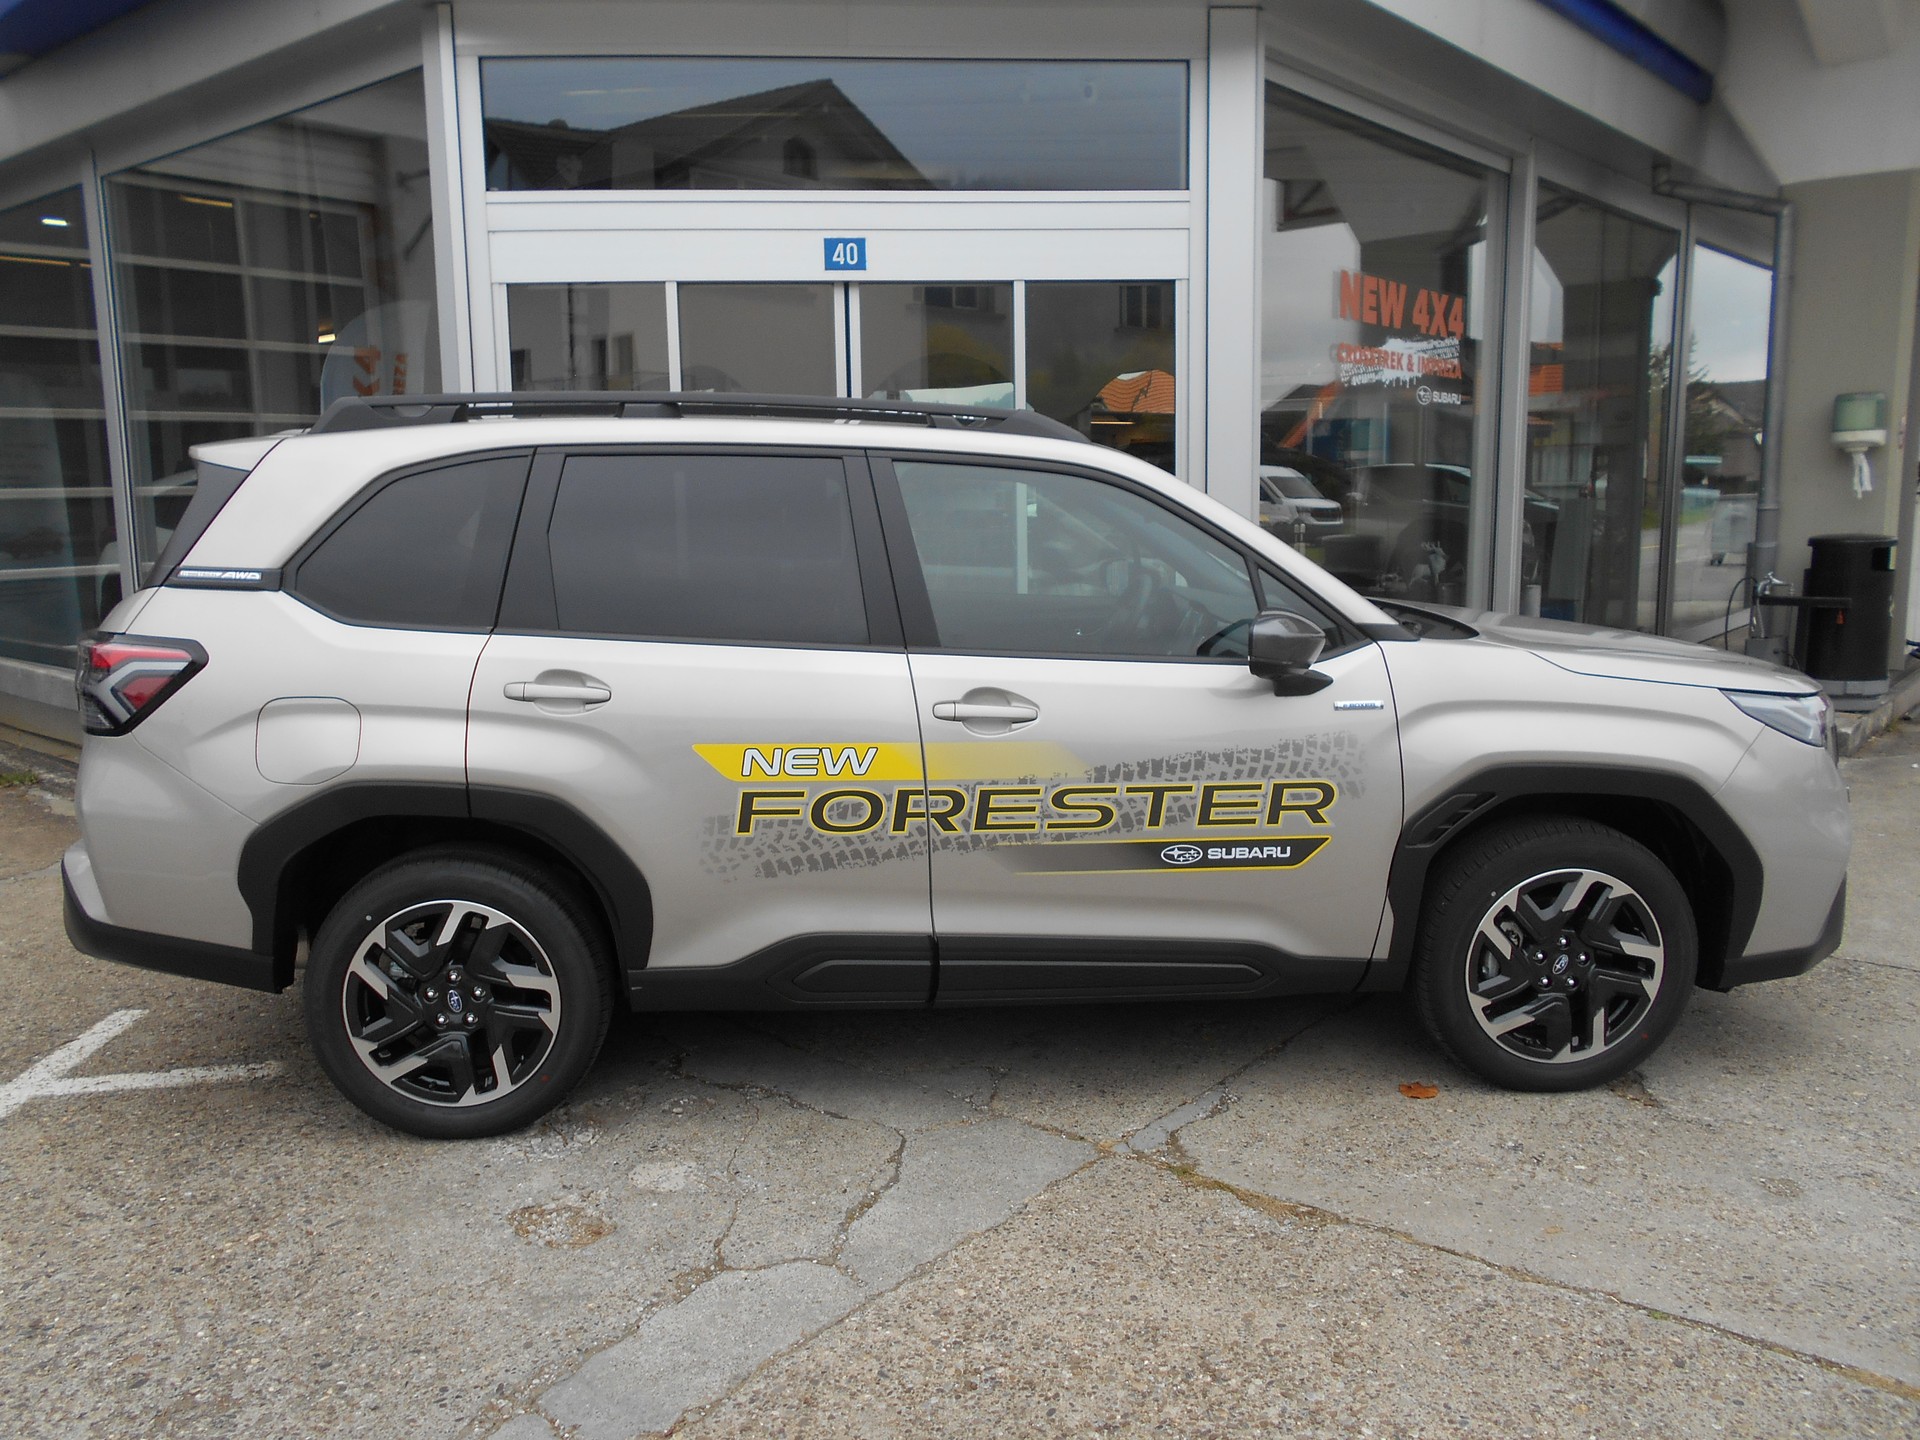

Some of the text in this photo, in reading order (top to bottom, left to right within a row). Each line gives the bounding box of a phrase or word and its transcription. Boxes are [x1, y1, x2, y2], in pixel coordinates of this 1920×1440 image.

[832, 242, 858, 265] 40
[1339, 269, 1464, 340] NEW 4X4
[1407, 355, 1415, 373] &
[1417, 357, 1463, 379] IMPREZA
[1432, 391, 1461, 405] SUBARU
[221, 571, 262, 581] AWD
[741, 747, 878, 777] NEW
[736, 780, 1339, 837] FORESTER
[1207, 846, 1291, 860] SUBARU
